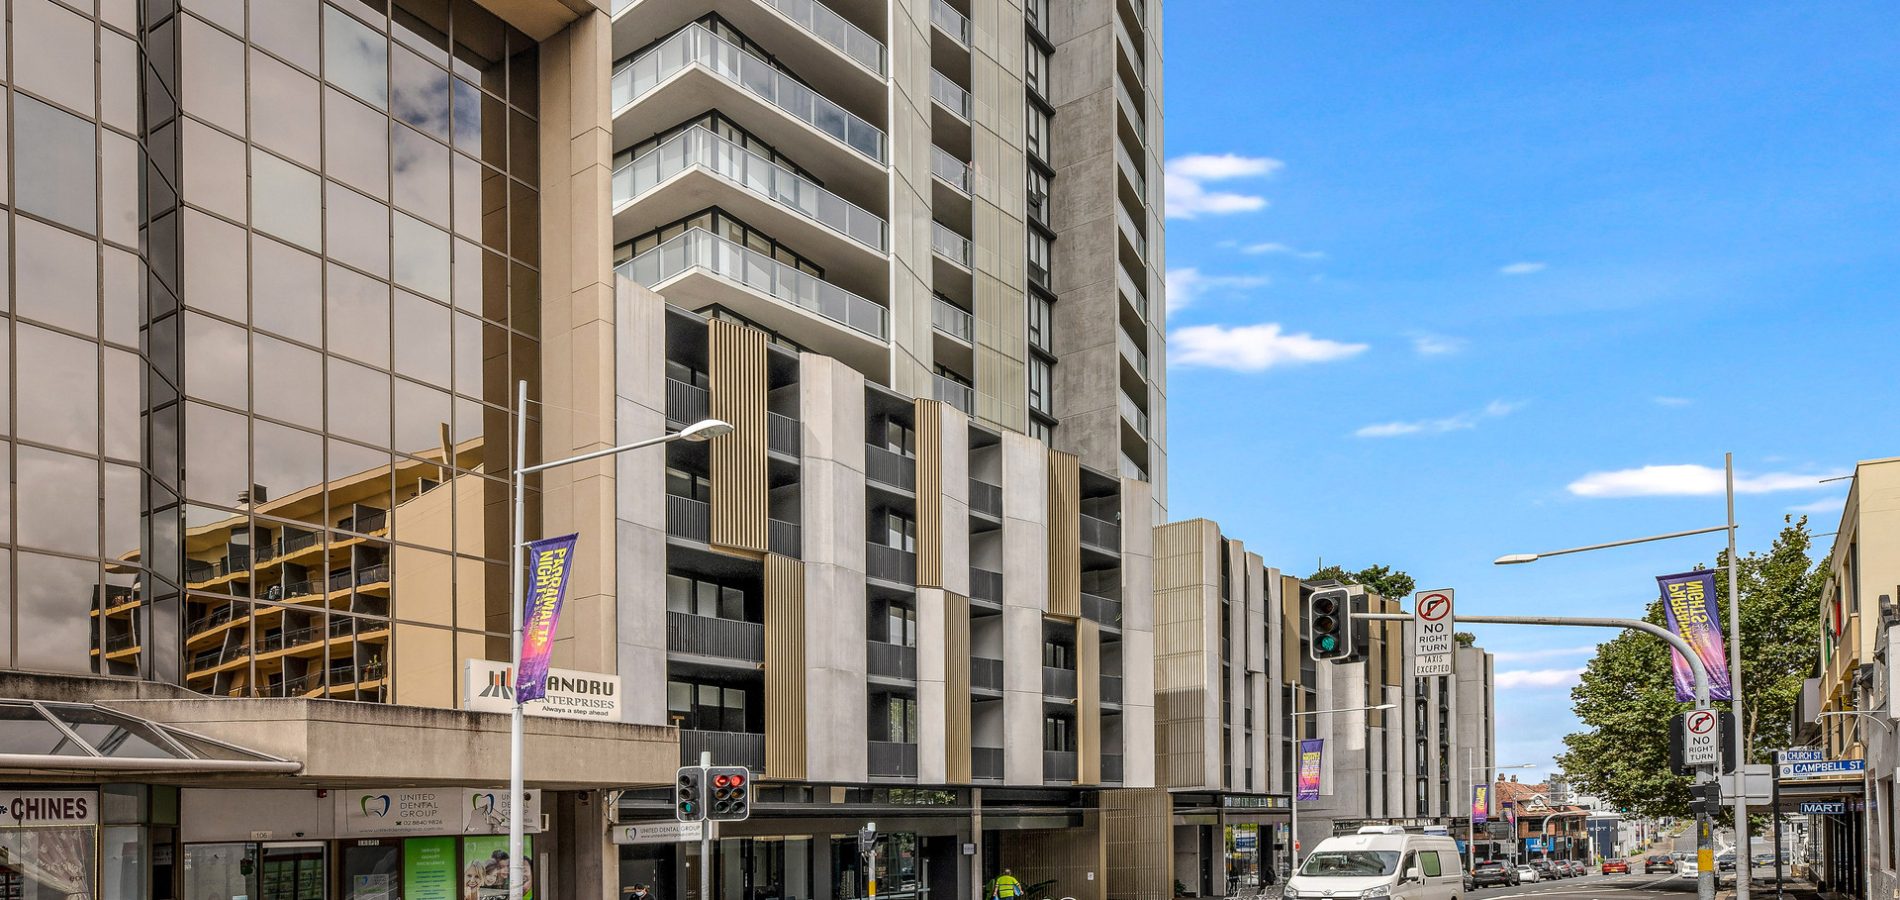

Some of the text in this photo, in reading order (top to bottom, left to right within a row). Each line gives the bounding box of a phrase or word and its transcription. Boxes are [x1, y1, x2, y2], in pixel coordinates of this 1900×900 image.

[1424, 623, 1444, 634] NO
[1419, 634, 1448, 643] RIGHT
[1421, 644, 1448, 652] TURN
[1424, 655, 1443, 663] TAXIS
[1416, 664, 1450, 674] EXCEPTED
[547, 675, 614, 696] ANDRU
[541, 705, 566, 714] Always
[573, 708, 587, 716] step
[588, 709, 609, 717] ahead
[1692, 736, 1710, 745] NO
[1688, 745, 1713, 753] RIGHT
[1787, 752, 1821, 760] CHURCH ST
[1794, 760, 1862, 773] CAMPBELL ST
[400, 793, 436, 801] UNITED
[11, 797, 88, 820] CHINES
[400, 801, 439, 809] DENTAL
[1804, 804, 1842, 812] MART
[400, 809, 438, 818] GROUP
